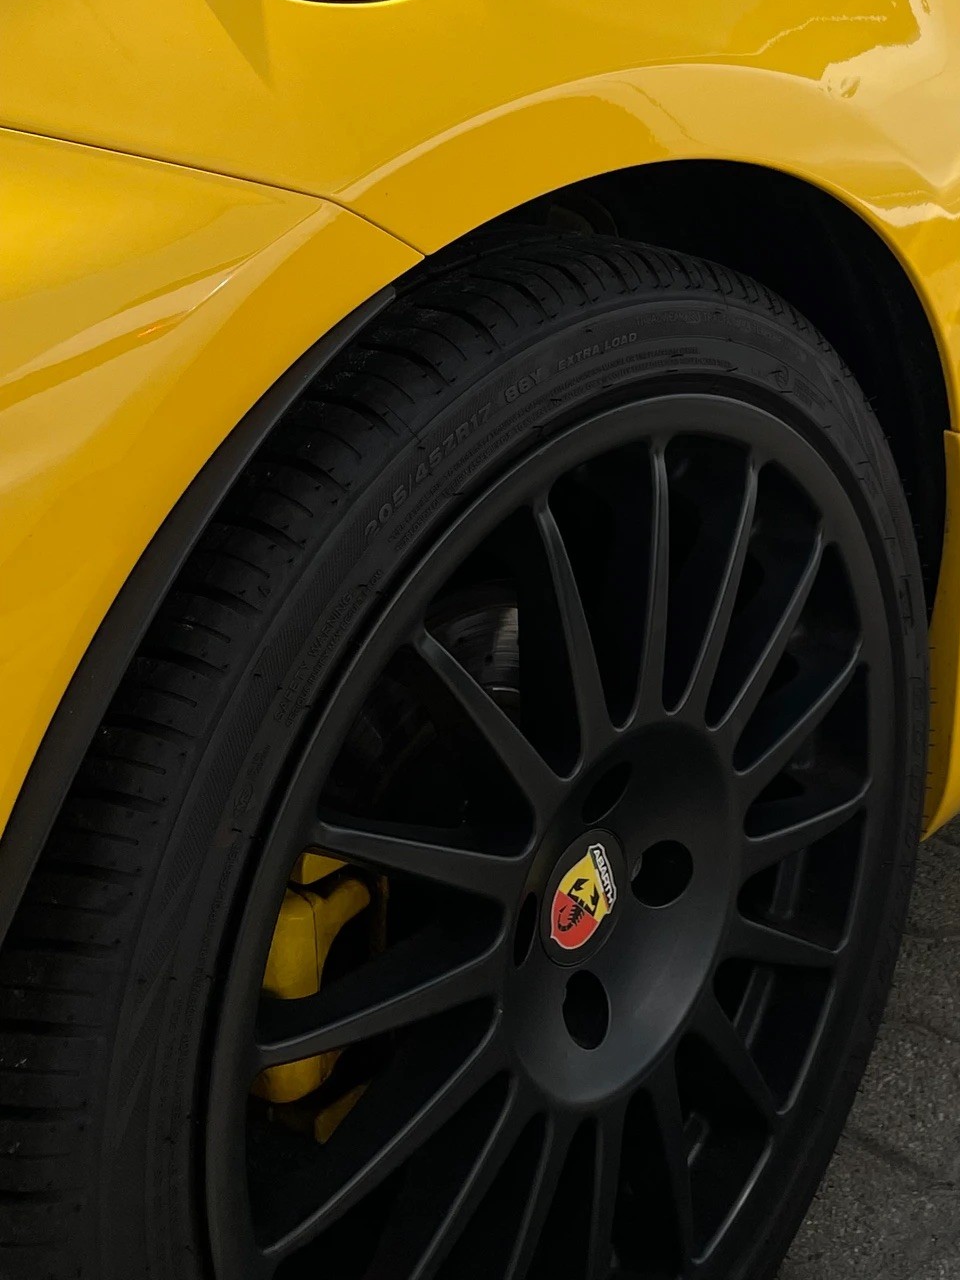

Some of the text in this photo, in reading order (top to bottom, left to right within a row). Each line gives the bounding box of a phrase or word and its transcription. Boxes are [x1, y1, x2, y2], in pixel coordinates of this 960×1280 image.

[557, 344, 600, 371] EXTRA
[604, 332, 638, 351] LOAD
[593, 850, 614, 904] ABARTH
